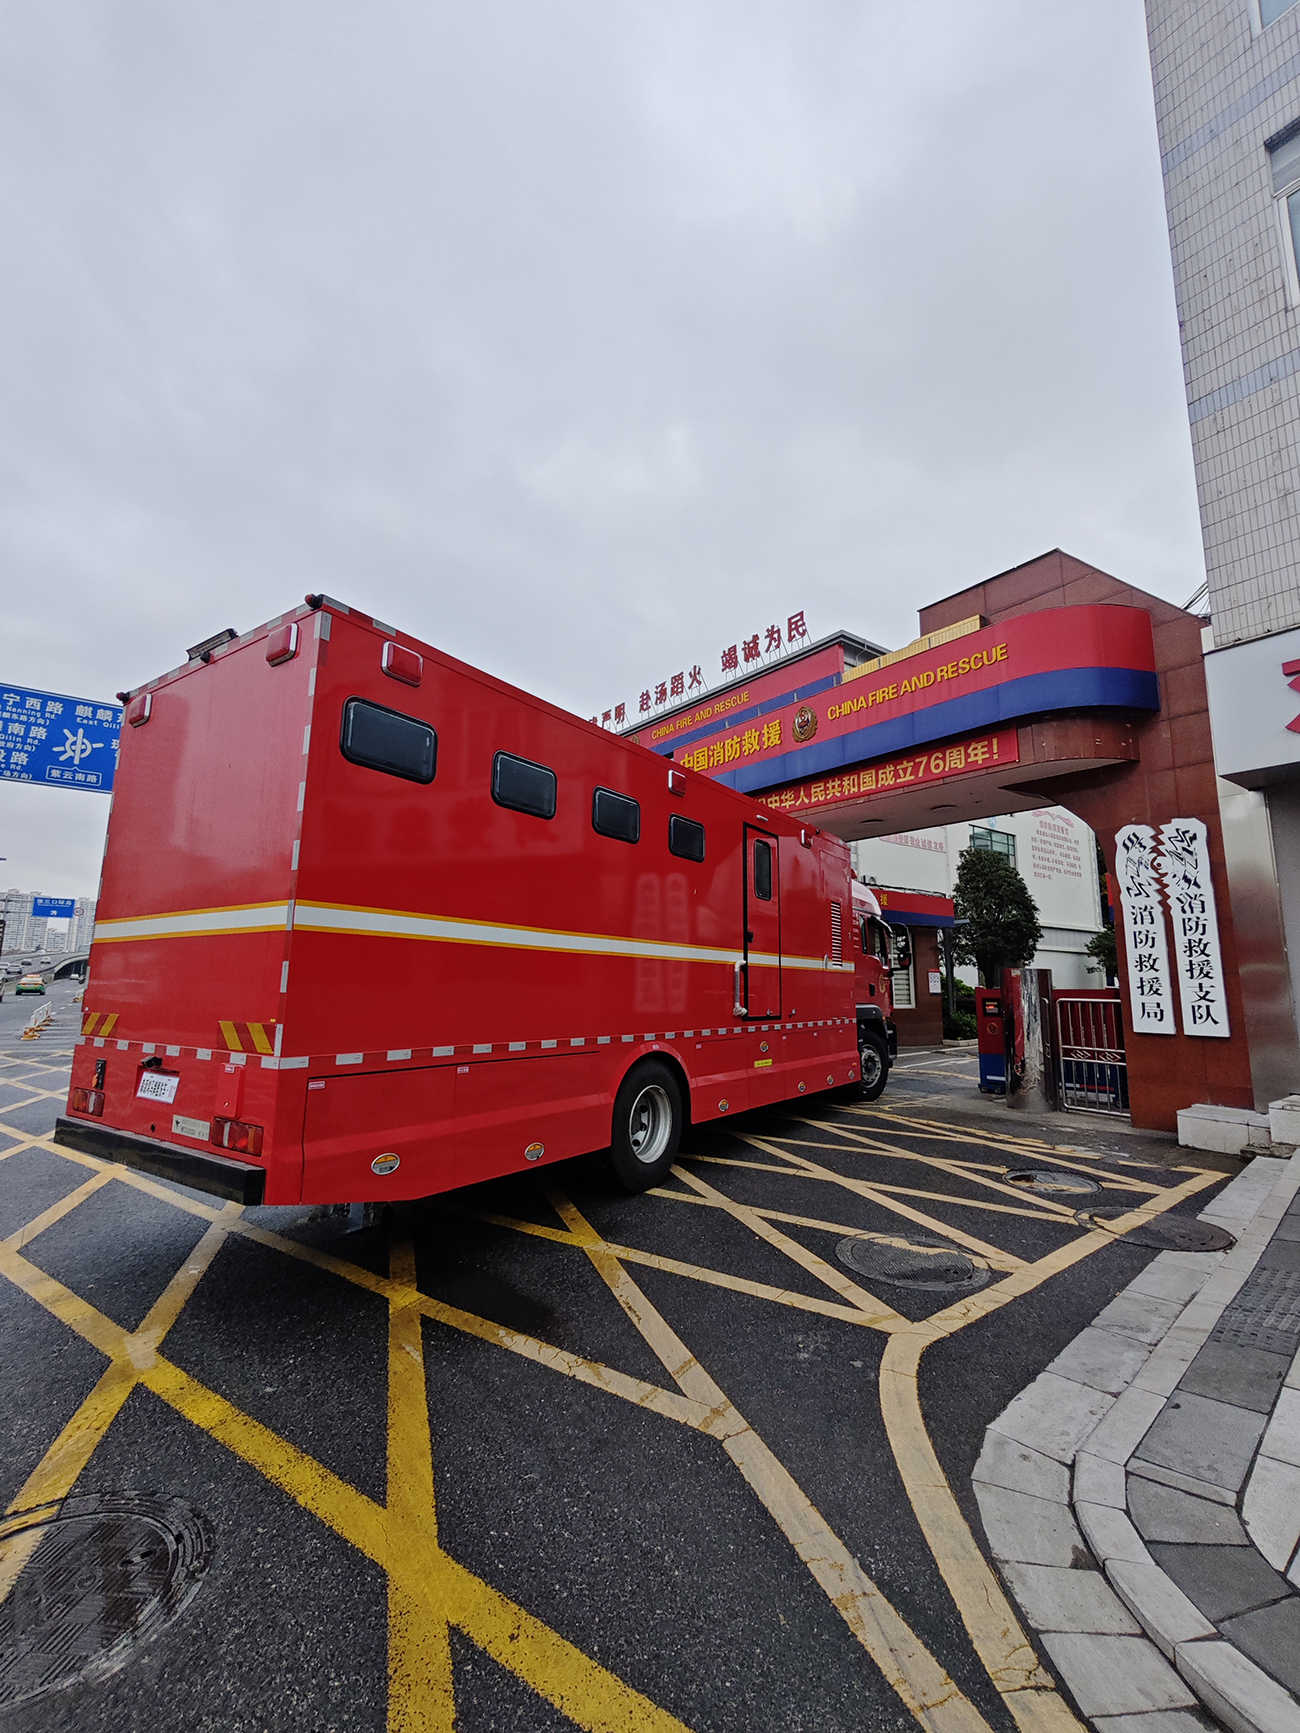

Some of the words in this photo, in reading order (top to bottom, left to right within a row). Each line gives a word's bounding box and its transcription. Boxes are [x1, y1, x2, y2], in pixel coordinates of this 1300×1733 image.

[639, 665, 702, 713] 赴汤蹈火
[721, 610, 807, 673] 竭诚为民
[827, 695, 868, 721] CHINA
[868, 683, 899, 708] FIRE
[900, 671, 935, 697] AND
[937, 643, 1008, 683] RESCUE
[76, 717, 98, 726] East
[651, 723, 675, 740] CHINA
[676, 715, 693, 730] FIRE
[694, 709, 713, 722] AND
[714, 691, 750, 714] RESCUE
[680, 719, 783, 772] 中国消防救援
[51, 769, 97, 783] 紫云南路
